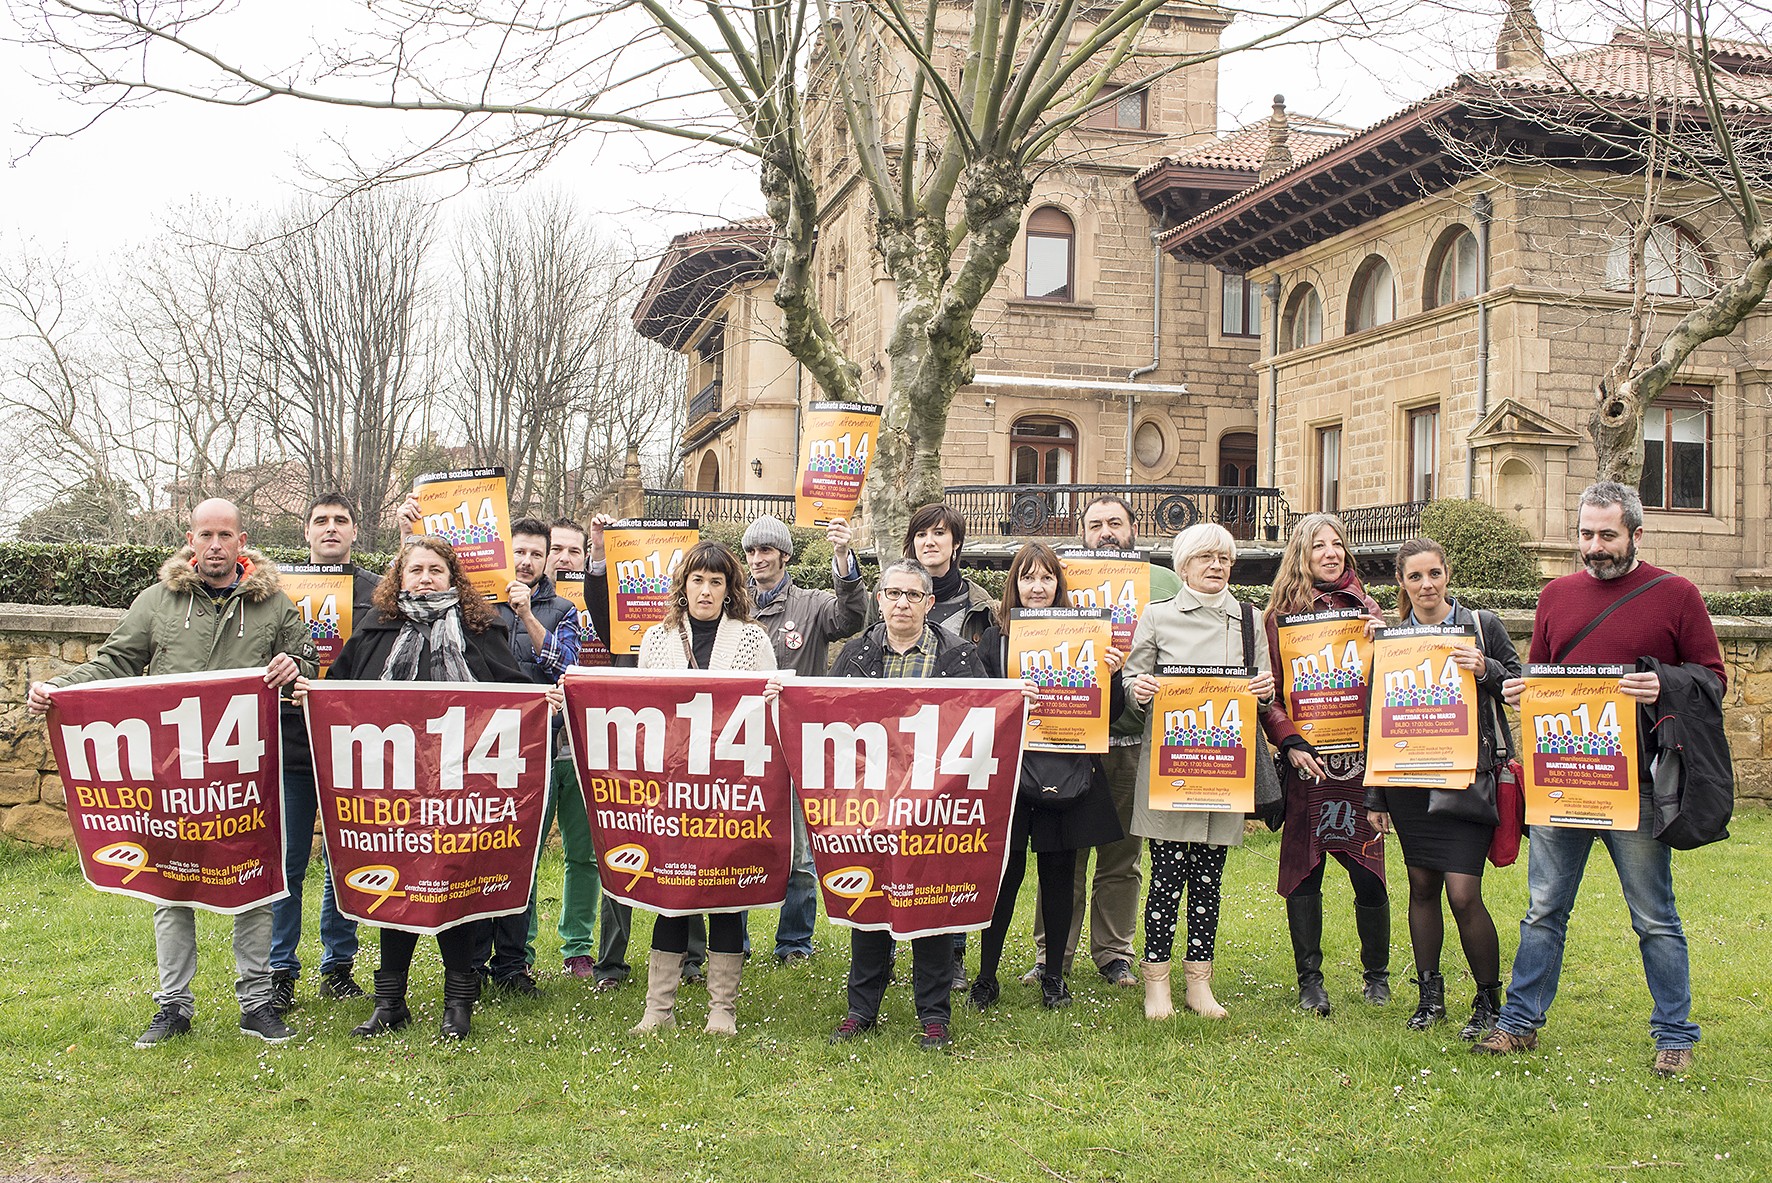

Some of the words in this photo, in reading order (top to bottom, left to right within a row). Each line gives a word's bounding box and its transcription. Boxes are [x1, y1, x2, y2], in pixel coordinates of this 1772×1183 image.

[809, 432, 868, 459] m14
[419, 472, 447, 482] aldaketa
[449, 469, 473, 478] soziala
[475, 468, 495, 476] orain!
[423, 497, 498, 535] m14
[275, 564, 293, 572] keta
[616, 549, 682, 580] m14
[1121, 551, 1140, 559] orain!
[1067, 580, 1138, 609] m14
[296, 594, 340, 623] 14
[1285, 613, 1314, 623] aldaketa
[1316, 611, 1339, 620] soziala
[1341, 609, 1361, 617] orain!
[1384, 627, 1414, 636] aldaketa
[1416, 626, 1441, 634] soziala
[1443, 625, 1464, 634] orain!
[1020, 639, 1098, 672] m14
[1291, 640, 1363, 675] m14
[1163, 666, 1195, 674] aldaketa
[1225, 667, 1247, 675] orain!
[1385, 655, 1462, 693] m14
[1530, 666, 1565, 674] aldaketa
[1567, 666, 1596, 674] soziala
[1598, 666, 1623, 674] orain!
[1571, 682, 1623, 696] alternativas
[1164, 699, 1243, 732] m14
[1533, 701, 1622, 740] m14
[76, 787, 152, 809] BILBO
[162, 781, 260, 814] IRUÑEA
[592, 778, 660, 807] BILBO
[668, 778, 765, 811] IRUÑEA
[336, 796, 410, 825] BILBO
[420, 792, 517, 825] IRUÑEA
[804, 798, 879, 827] BILBO
[887, 795, 986, 827] IRUÑEA
[82, 808, 266, 840] manifestazioak
[597, 809, 772, 839] manifestazioak
[340, 825, 521, 854] manifestazioak
[812, 828, 989, 856] manifestazioak
[163, 870, 200, 881] eskubide
[202, 876, 236, 885] sozialen
[202, 866, 229, 876] euskal
[232, 859, 259, 873] herriko
[657, 876, 695, 885] eskubide
[698, 877, 735, 886] sozialen
[699, 867, 728, 876] euskal
[732, 866, 764, 875] herriko
[410, 893, 447, 903] eskubide
[449, 886, 480, 899] sozialen
[450, 878, 476, 890] euskal
[478, 874, 508, 883] herriko
[915, 885, 944, 895] euskal
[946, 883, 976, 892] herriko
[914, 895, 948, 905] sozialen
